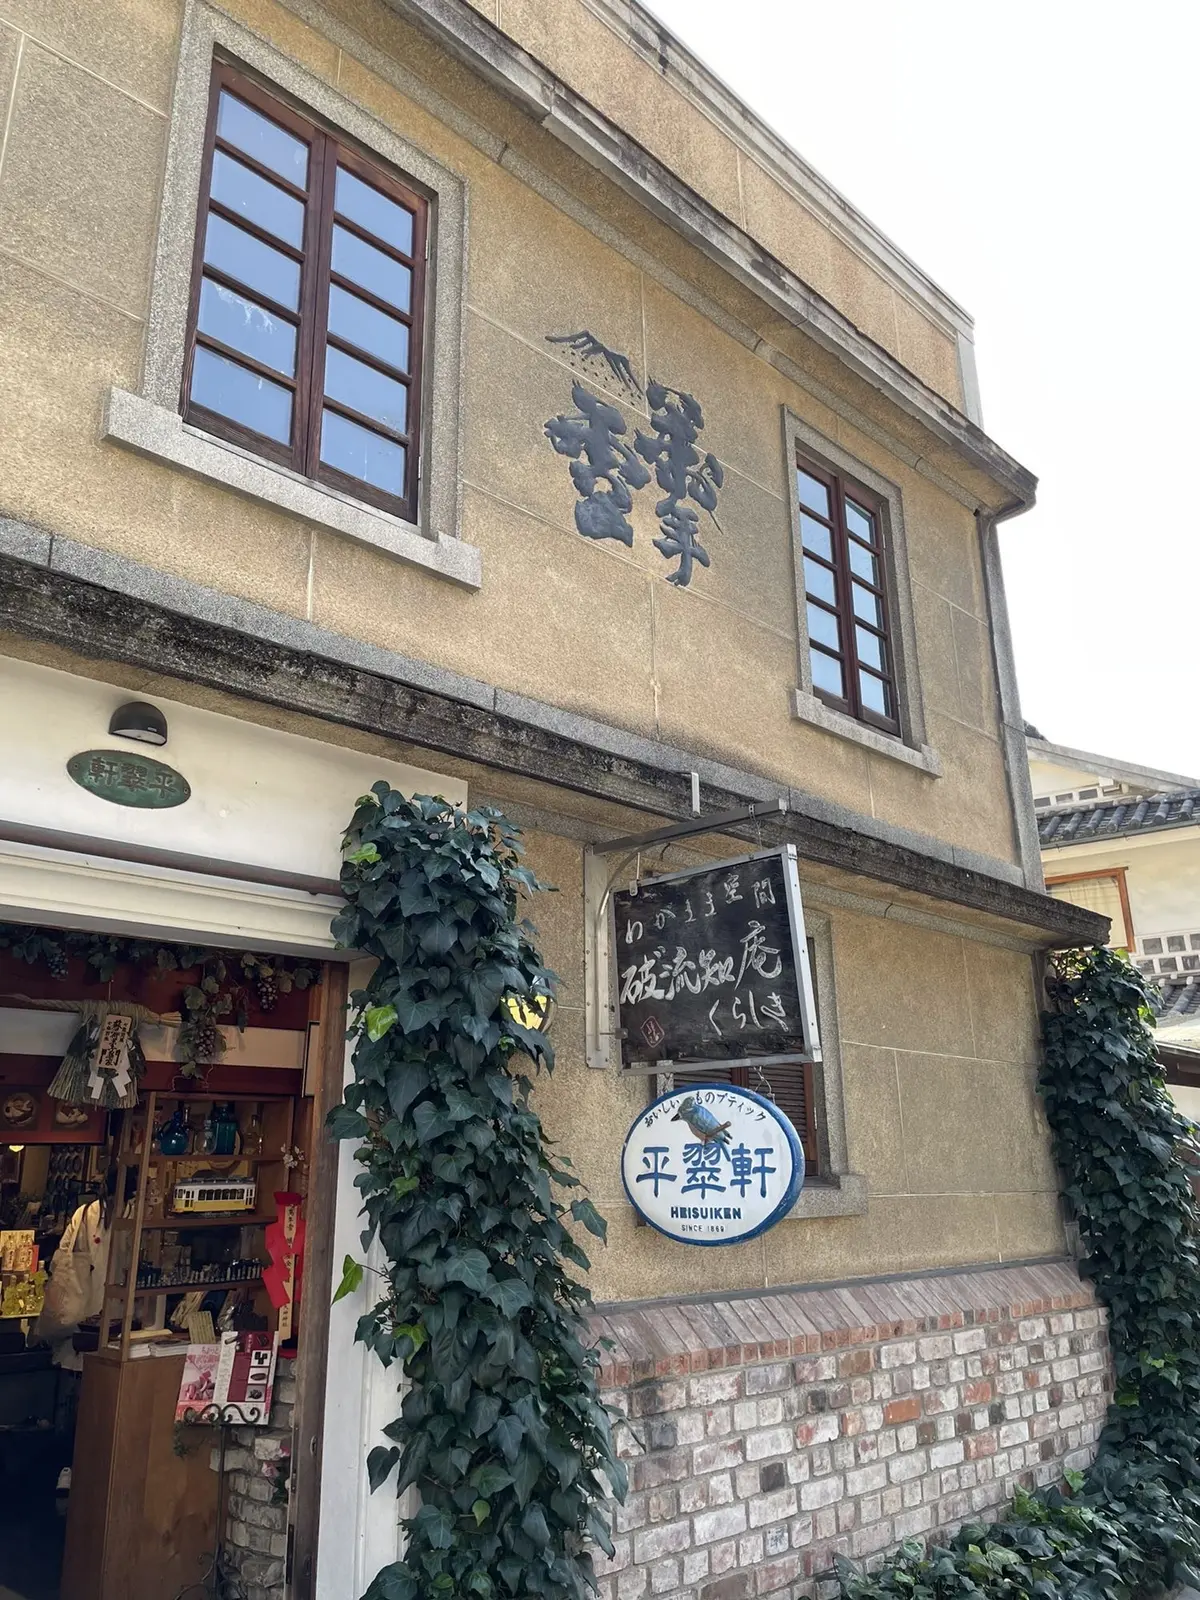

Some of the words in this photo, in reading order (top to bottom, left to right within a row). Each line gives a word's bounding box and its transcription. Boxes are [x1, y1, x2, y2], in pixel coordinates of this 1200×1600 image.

[635, 1142, 777, 1200] 平翠軒
[670, 1206, 742, 1220] HEISUIKEN
[681, 1224, 703, 1232] SINCE
